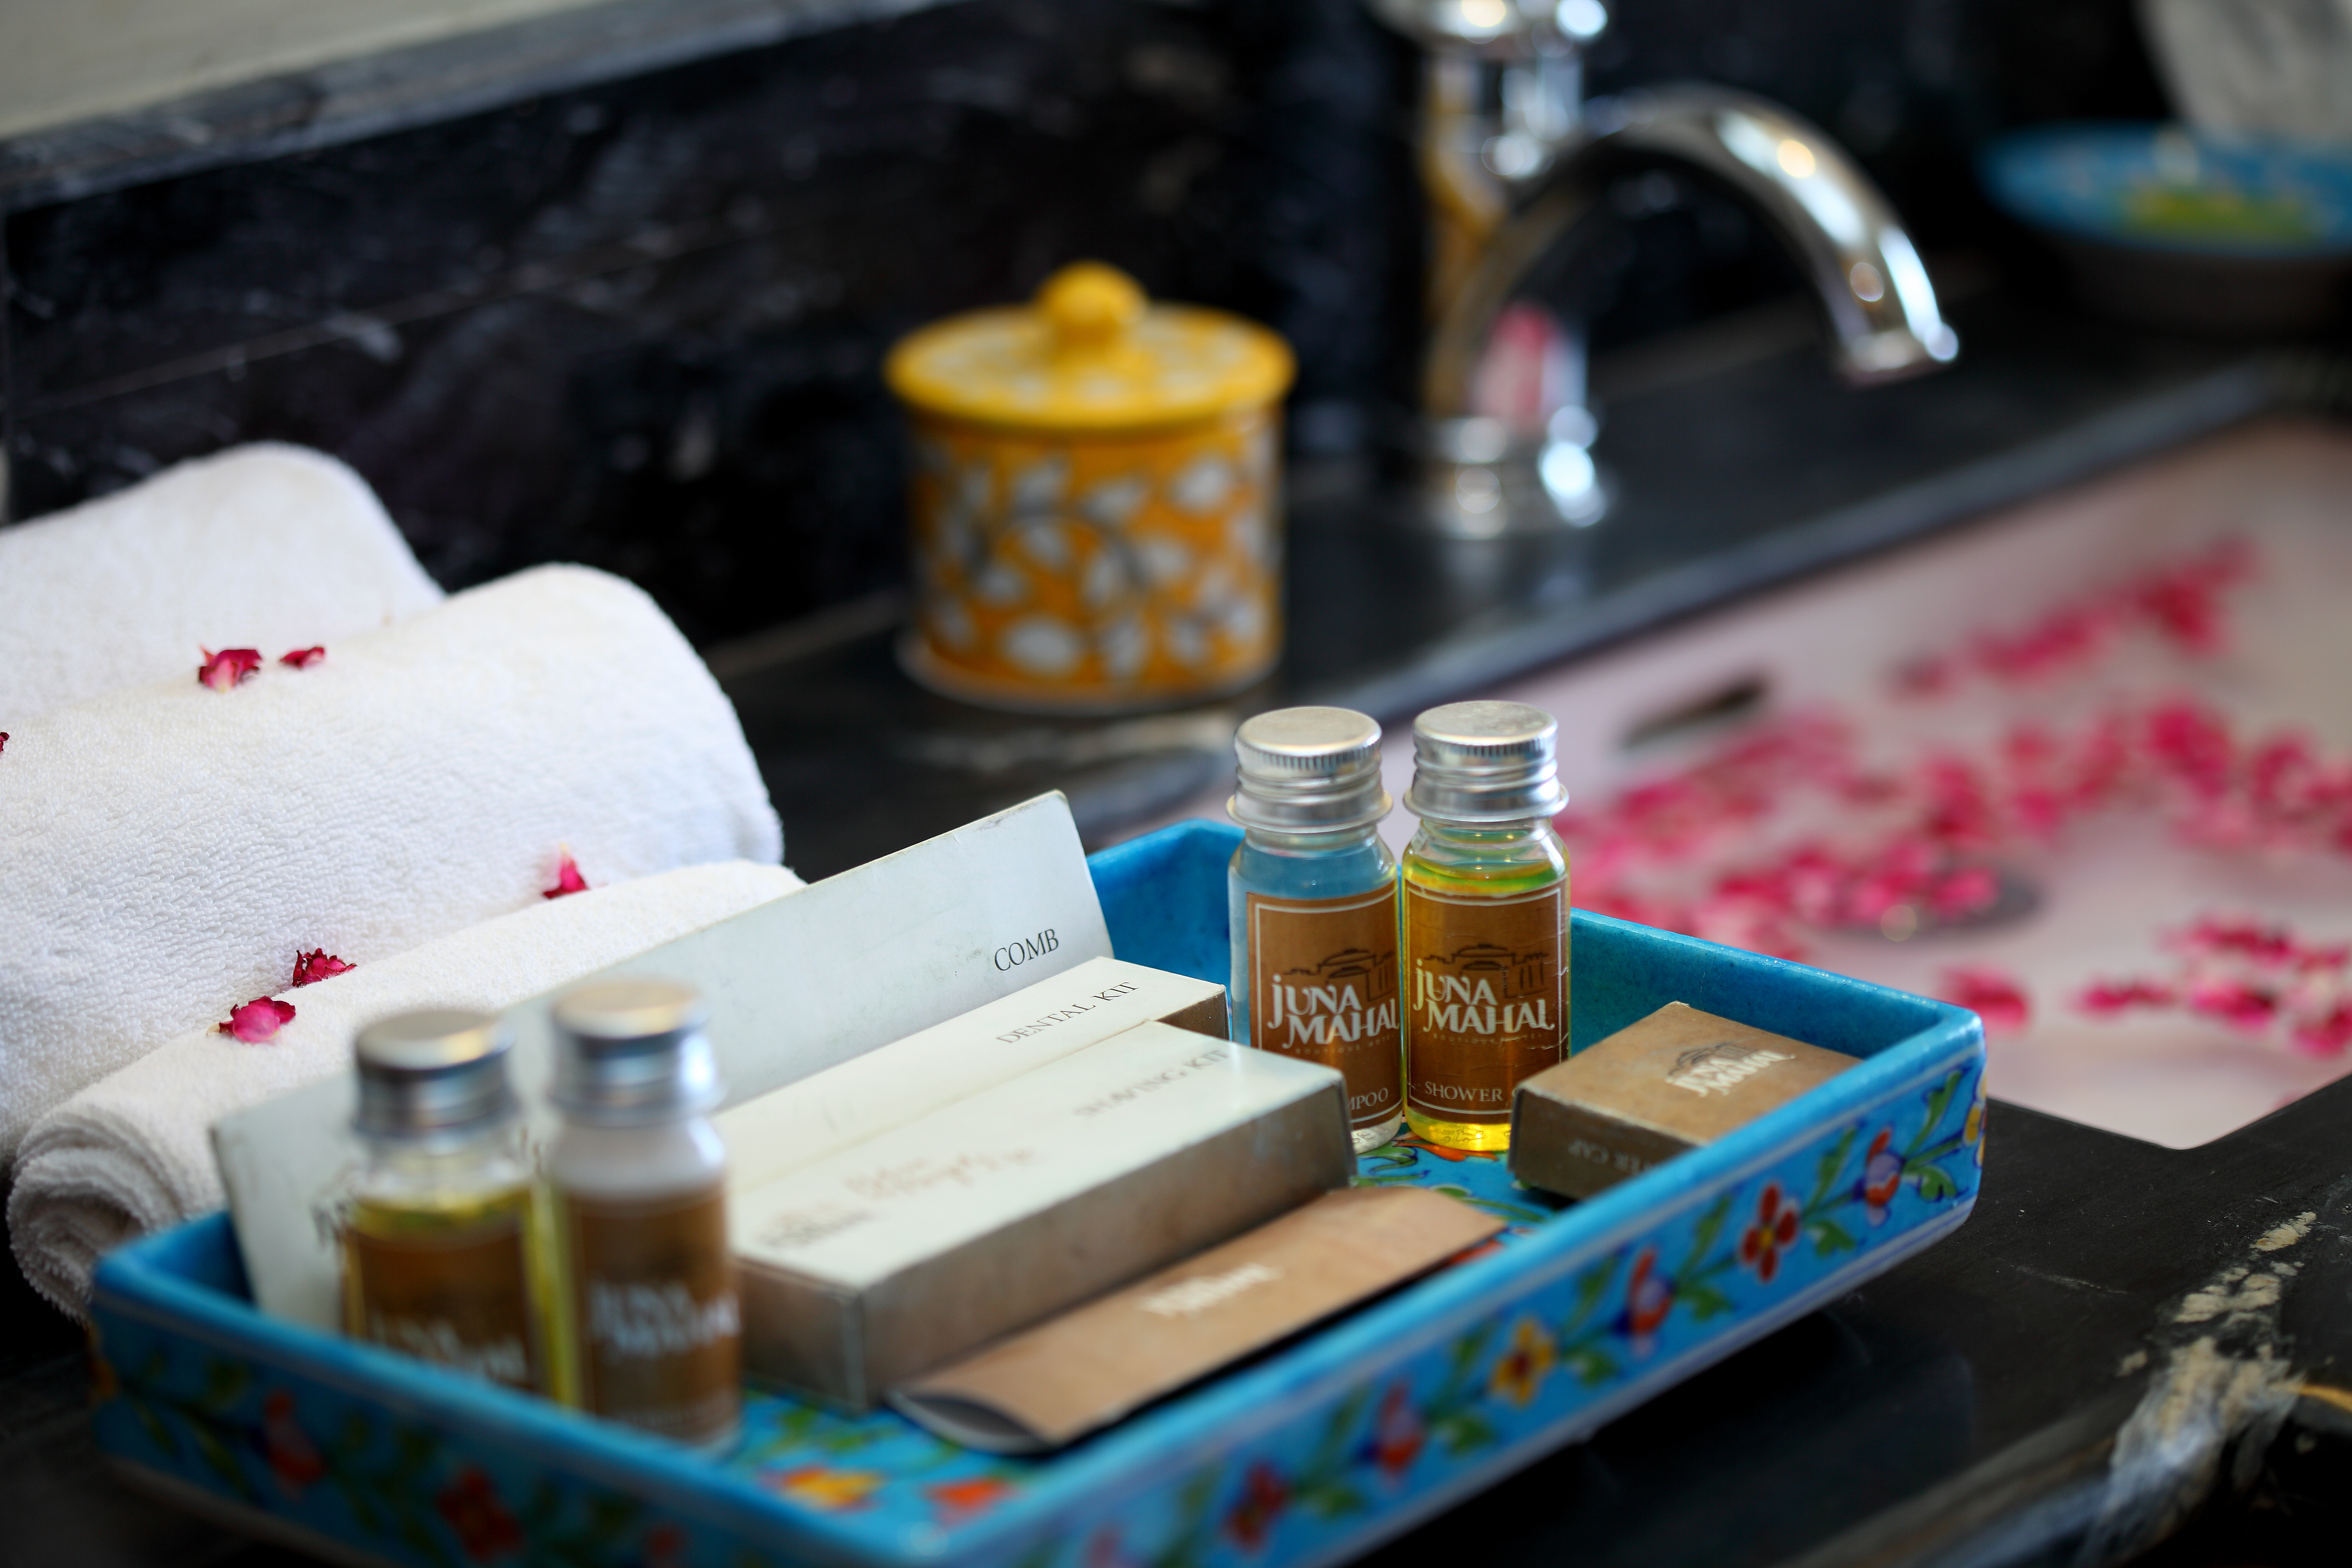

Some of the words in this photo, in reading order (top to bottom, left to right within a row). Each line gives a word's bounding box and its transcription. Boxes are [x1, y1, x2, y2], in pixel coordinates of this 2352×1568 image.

[994, 928, 1058, 971] COMB
[996, 1003, 1096, 1044] DENTAL
[1091, 982, 1139, 1001] KIT
[1282, 998, 1400, 1049] MAHAL
[1423, 999, 1555, 1034] MAHAL
[1425, 1081, 1503, 1103] SHOWER
